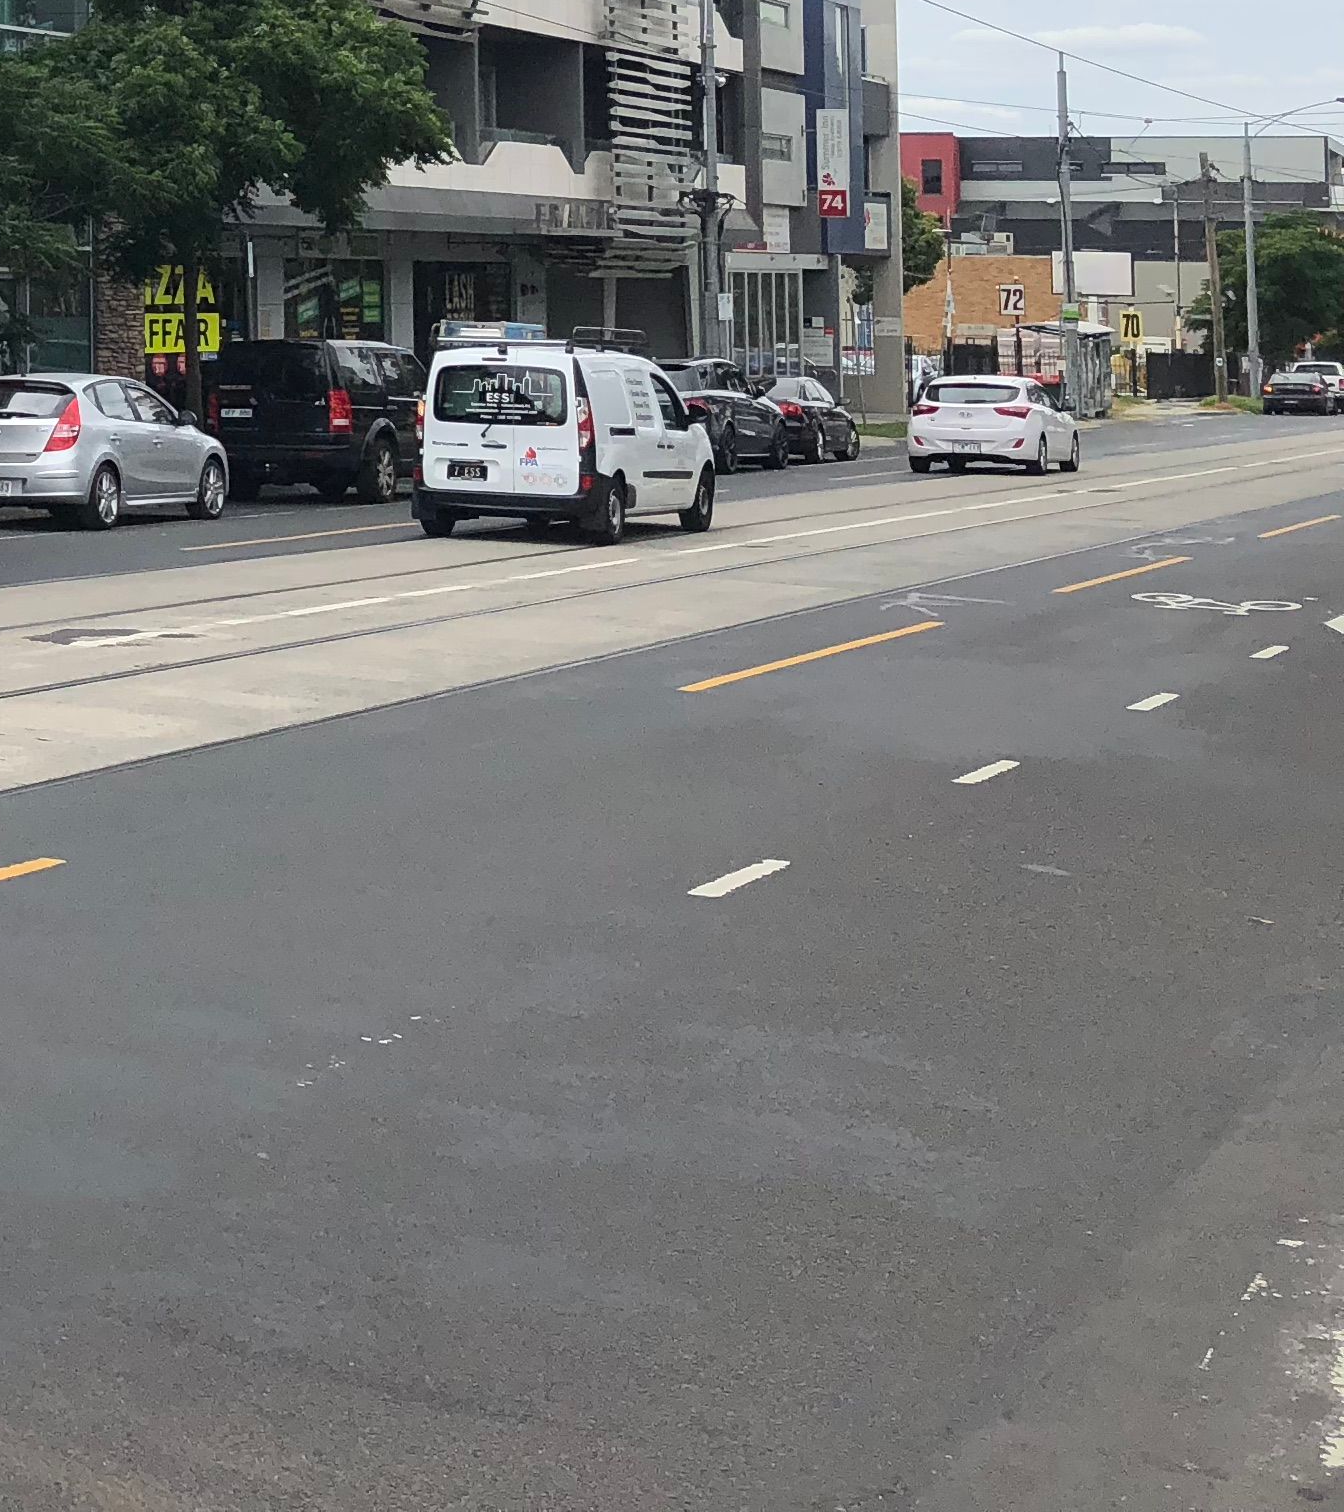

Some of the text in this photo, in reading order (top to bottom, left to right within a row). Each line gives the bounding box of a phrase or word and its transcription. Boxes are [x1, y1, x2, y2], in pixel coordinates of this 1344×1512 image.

[821, 194, 844, 210] 74
[1000, 289, 1023, 311] 72
[145, 318, 209, 349] FFAR
[1122, 313, 1140, 338] 70
[486, 392, 510, 403] ESS
[519, 457, 538, 467] FPA
[464, 467, 481, 477] ESS
